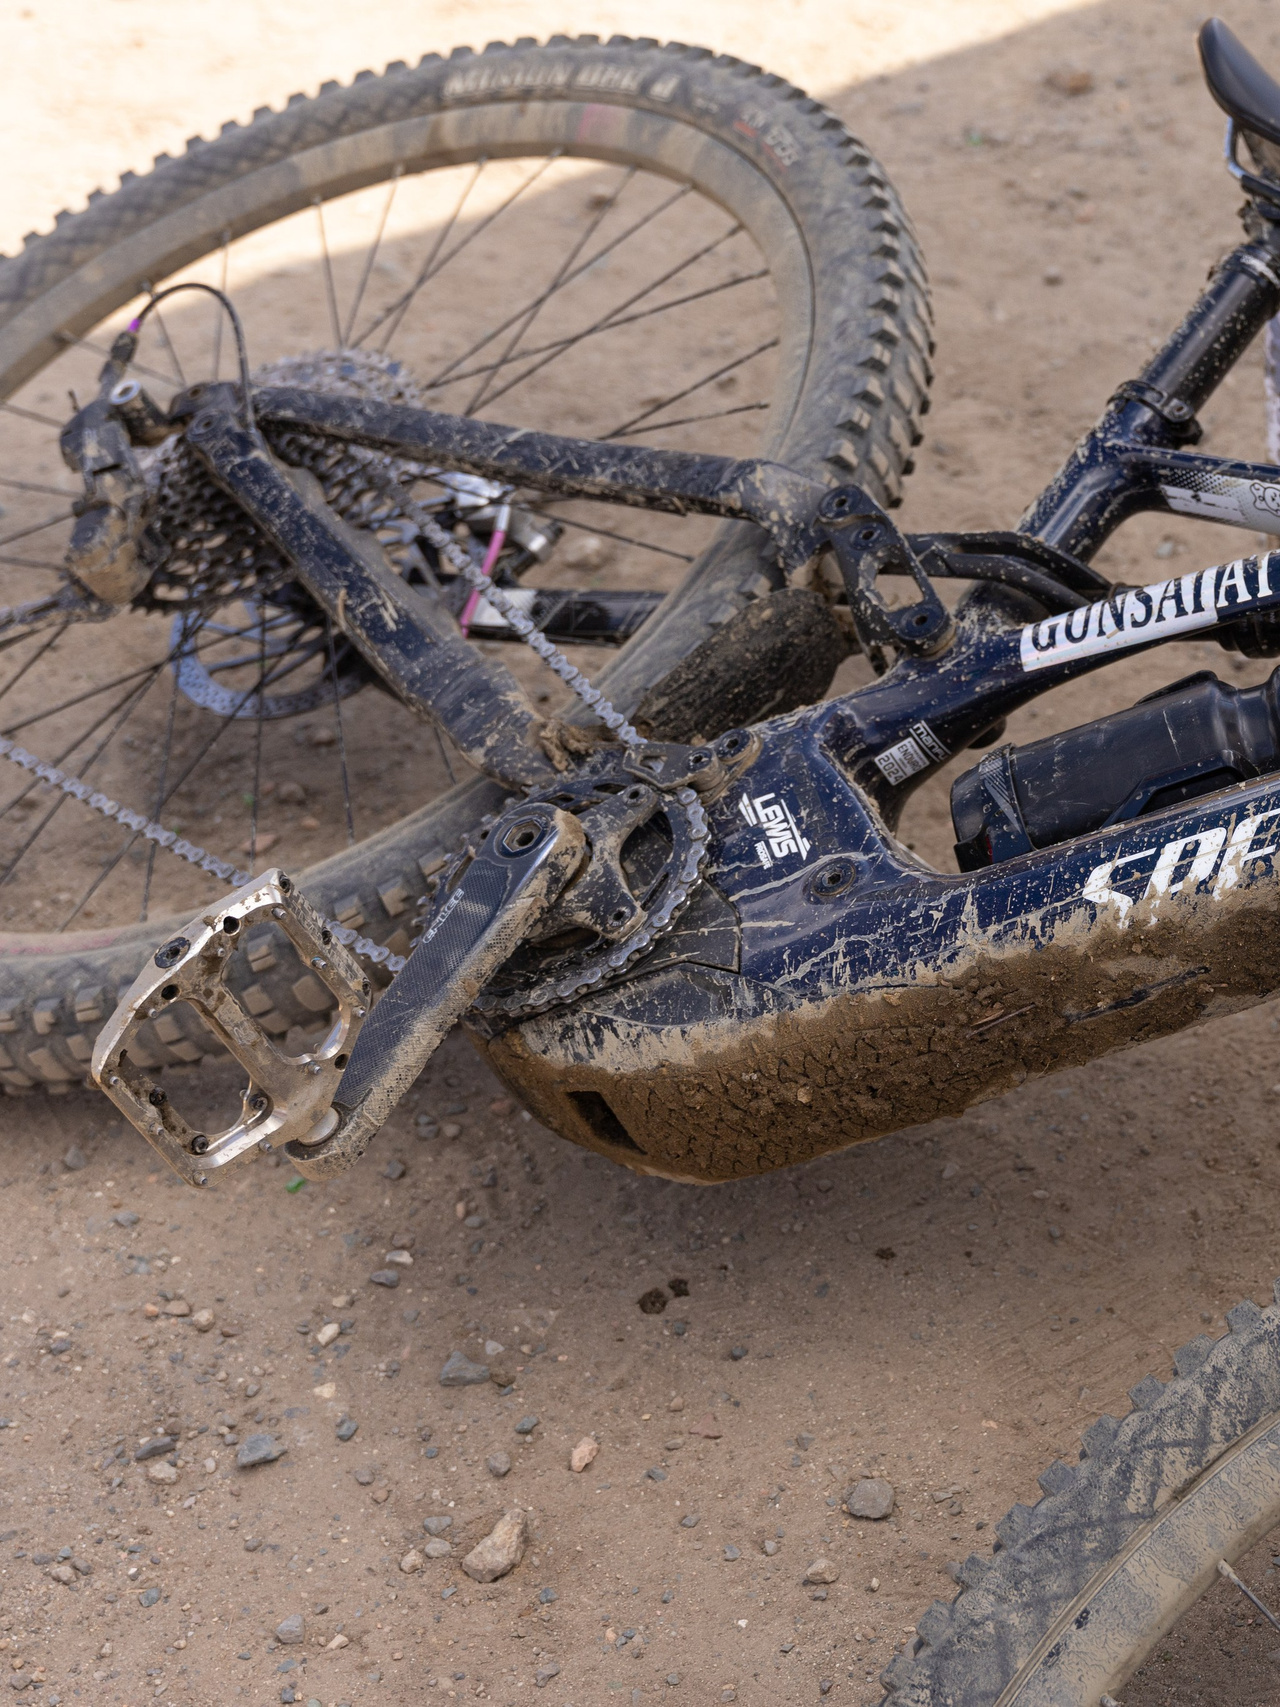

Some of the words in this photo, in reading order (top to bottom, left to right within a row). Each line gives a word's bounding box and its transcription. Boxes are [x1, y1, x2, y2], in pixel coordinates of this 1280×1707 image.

[877, 754, 904, 784] 2024
[898, 743, 922, 772] ENDURO
[752, 792, 799, 858] LEWIS
